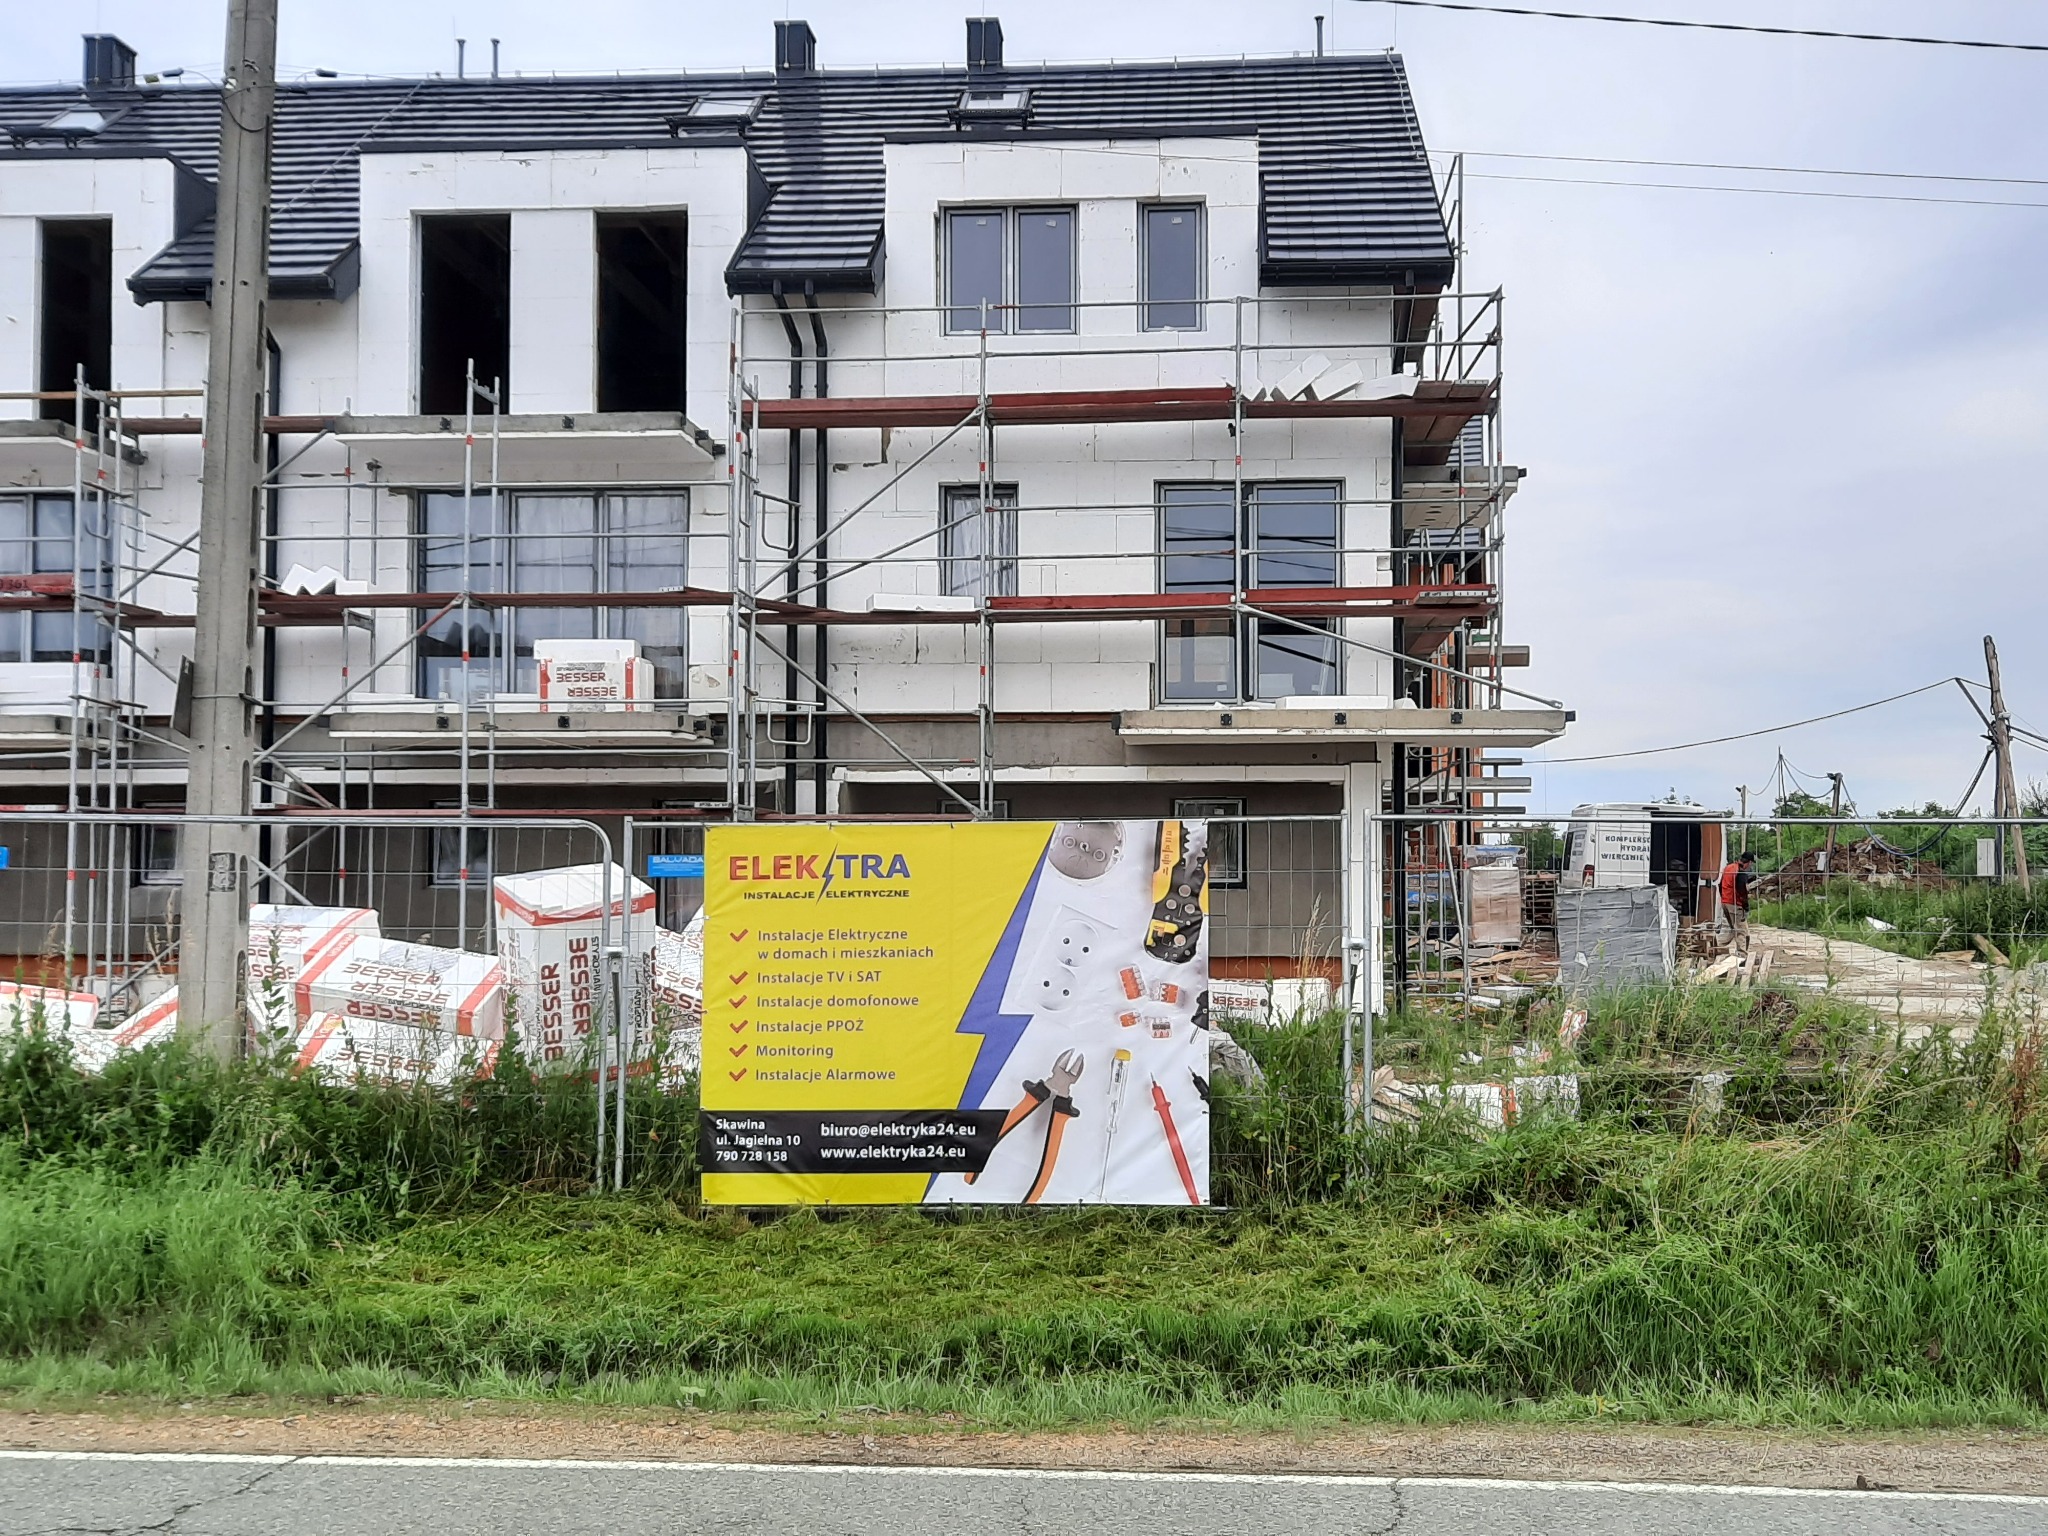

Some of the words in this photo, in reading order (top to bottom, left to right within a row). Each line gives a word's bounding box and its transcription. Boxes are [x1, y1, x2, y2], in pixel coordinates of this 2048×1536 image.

[556, 672, 606, 683] BESSER
[567, 686, 617, 697] BESSER
[743, 891, 815, 900] INSTALACJE
[826, 889, 910, 898] ELEKTRYCZNE
[757, 929, 825, 944] Instalacje
[828, 928, 908, 943] Elektryczne
[757, 950, 769, 960] w
[773, 947, 828, 959] domach
[832, 947, 836, 959] i
[840, 945, 934, 959] mieszkaniach
[342, 963, 441, 986] BESSER
[757, 972, 824, 986] Instalacje
[826, 971, 845, 982] TV
[848, 971, 852, 982] i
[856, 970, 882, 982] SAT
[350, 981, 452, 1005] BESSER
[569, 937, 592, 1036] BESSER
[757, 995, 823, 1009] Instalacje
[827, 994, 919, 1006] domofonowe
[1212, 995, 1258, 1007] BESSER
[541, 962, 564, 1061] BESSER
[756, 1021, 823, 1035] Instalacje
[826, 1016, 865, 1032] PPOŻ
[756, 1045, 834, 1059] Monitoring
[756, 1069, 822, 1083] Instalacje
[826, 1068, 896, 1080] Alarmowe
[715, 1119, 766, 1131] Skawina
[820, 1122, 977, 1139] biuro@elektryka24.eu
[716, 1134, 731, 1147] ul.
[733, 1135, 783, 1149] Jagielna
[786, 1134, 801, 1147] 10
[715, 1150, 738, 1162] 790
[741, 1150, 763, 1162] 728
[766, 1150, 788, 1162] 158
[820, 1145, 967, 1161] www.elektryka24.eu
